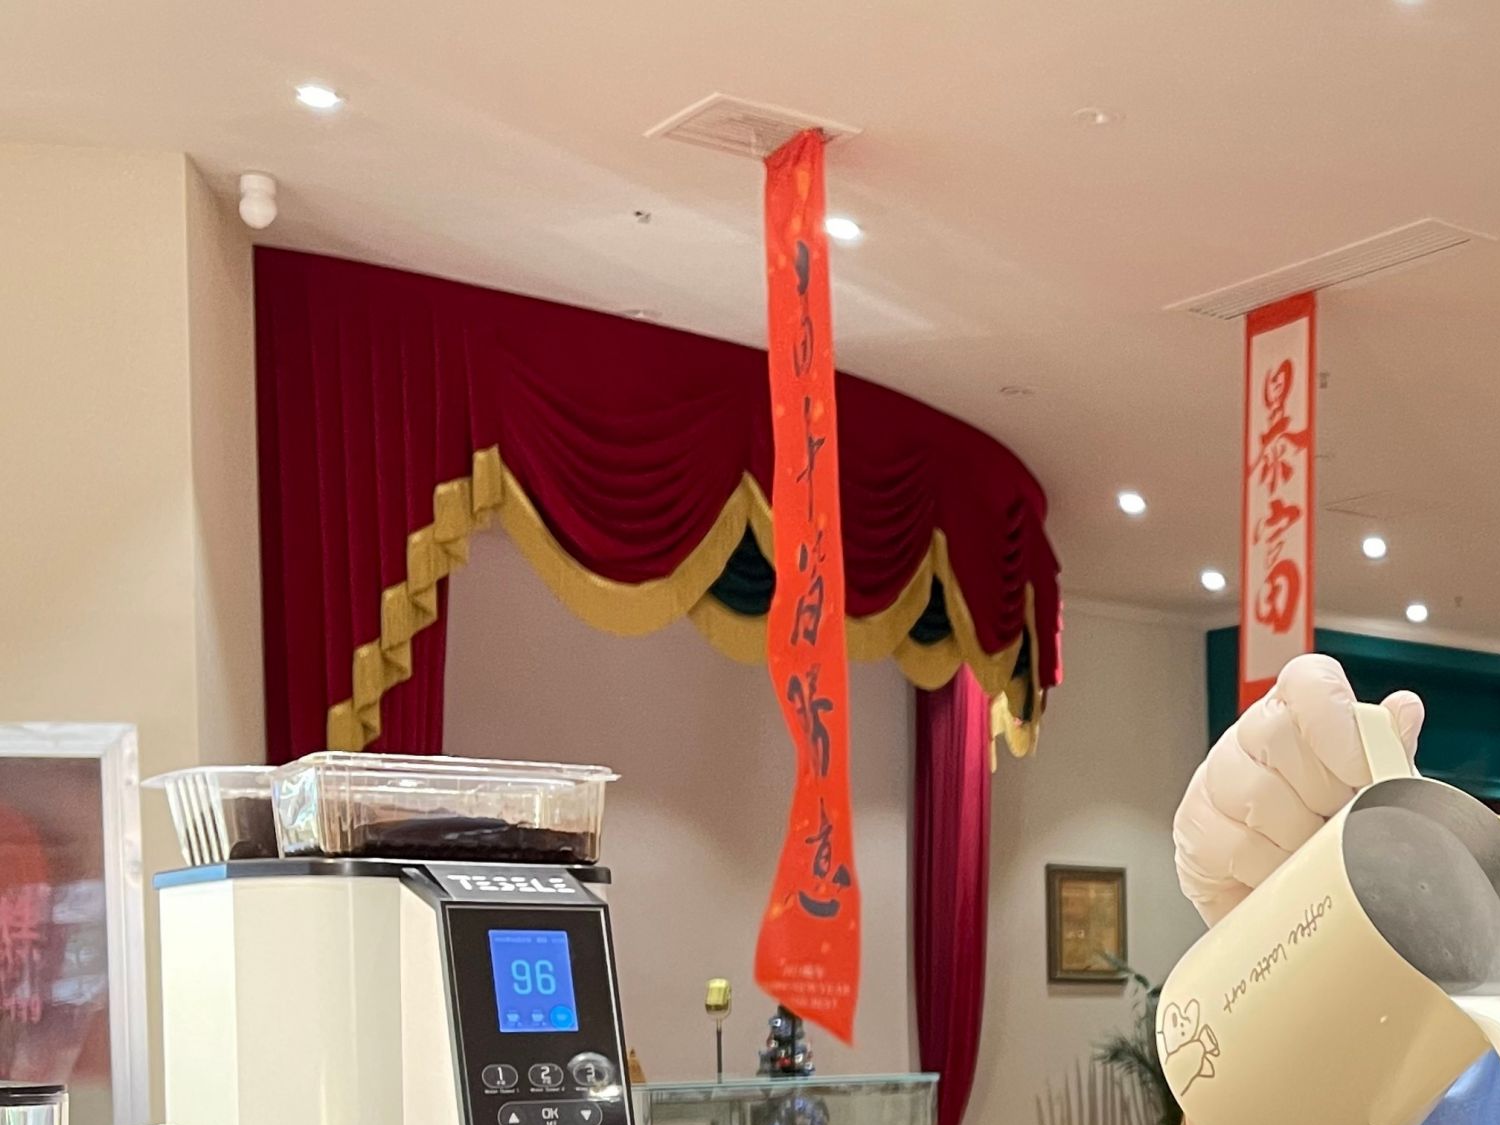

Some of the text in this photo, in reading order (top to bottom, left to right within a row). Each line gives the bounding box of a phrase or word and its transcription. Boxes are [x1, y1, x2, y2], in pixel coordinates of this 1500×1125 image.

[1249, 358, 1309, 634] 暴富
[447, 874, 576, 894] TESELE
[1223, 895, 1333, 1014] coffee latte art
[511, 959, 556, 995] 96
[542, 1107, 559, 1120] OK
